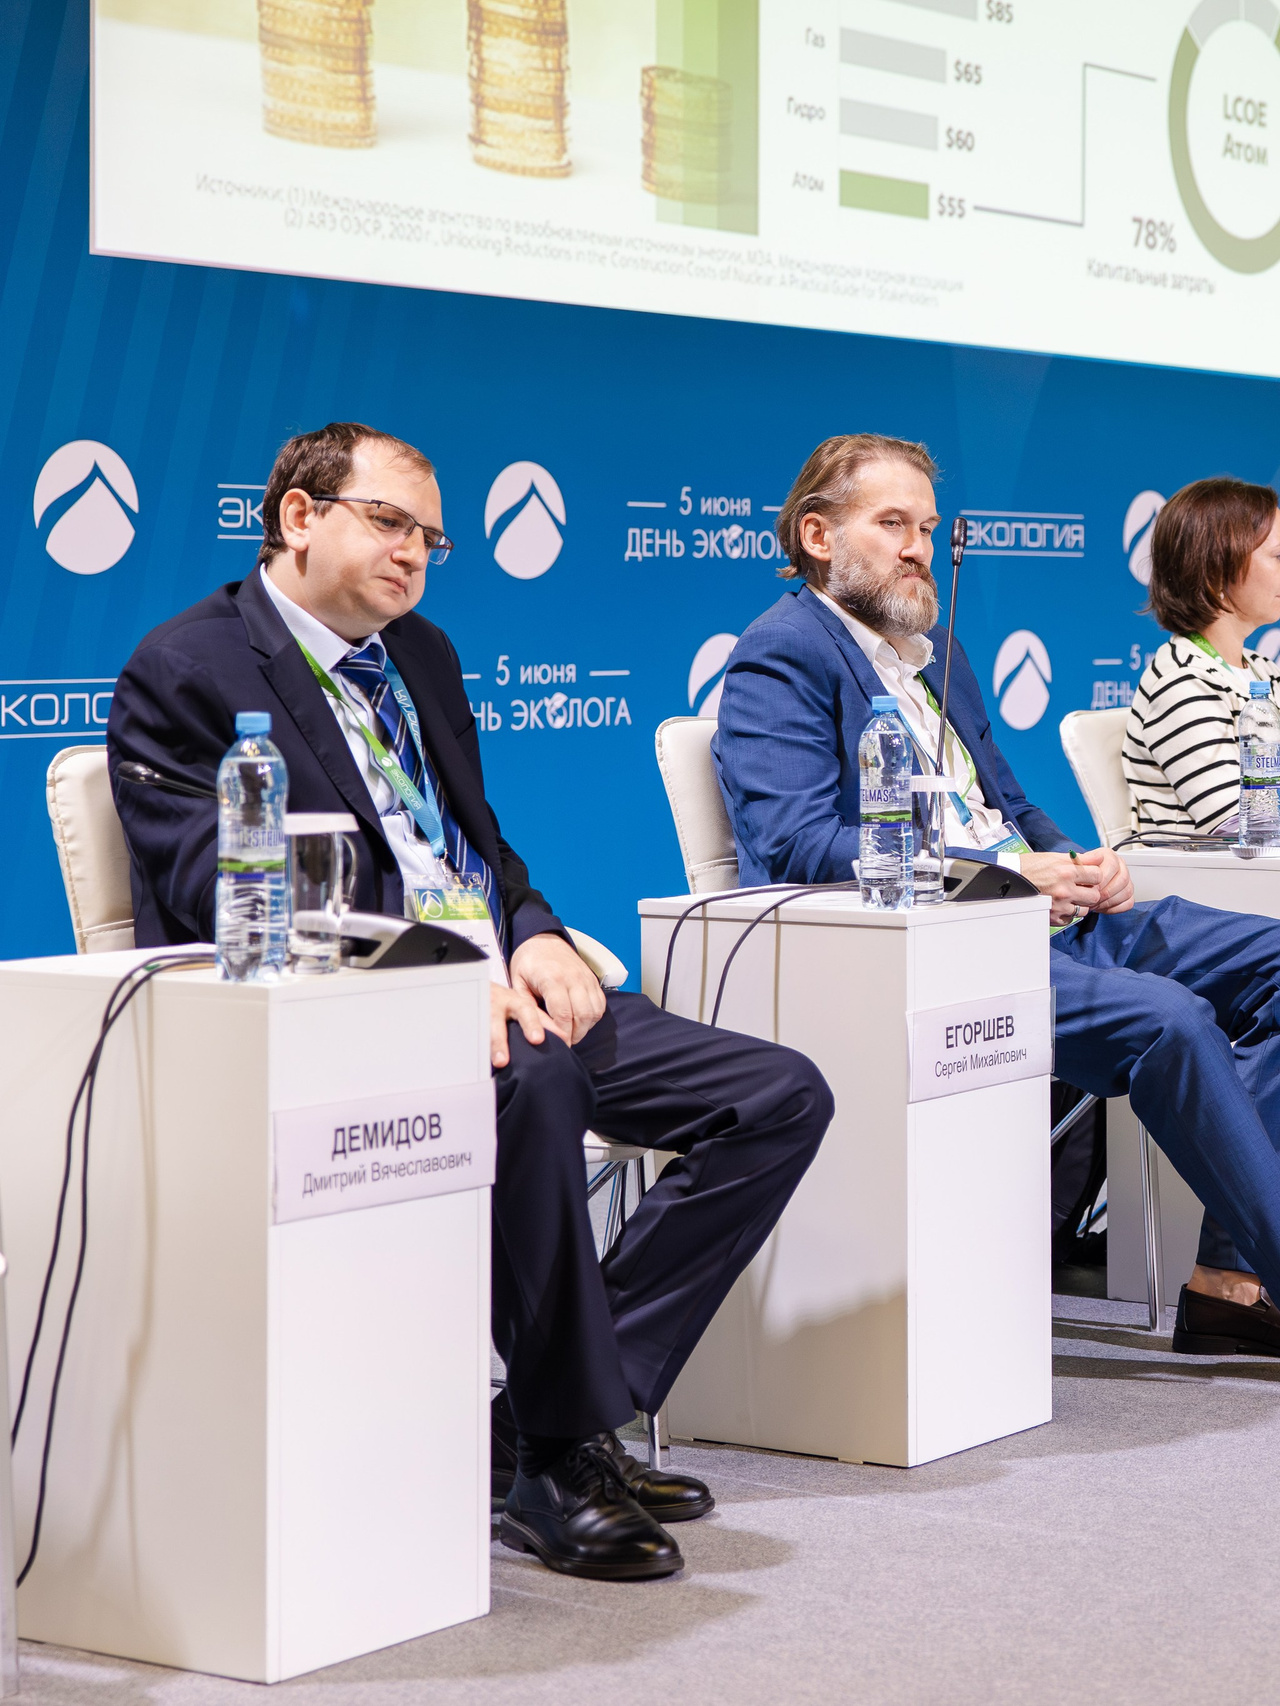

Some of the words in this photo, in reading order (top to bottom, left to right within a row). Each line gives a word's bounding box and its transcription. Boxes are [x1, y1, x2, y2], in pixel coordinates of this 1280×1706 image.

[986, 0, 1014, 24] $85
[805, 26, 826, 49] Газ
[954, 58, 983, 86] $65
[786, 96, 826, 123] Гидро
[1222, 94, 1268, 128] LCOE
[945, 125, 976, 152] $60
[1221, 132, 1269, 166] Атом
[791, 170, 825, 192] Атом
[937, 192, 967, 219] $55
[1131, 215, 1178, 254] 78%
[1086, 256, 1169, 289] Капитальные
[679, 486, 693, 516] 5
[700, 496, 752, 517] июня
[624, 527, 686, 562] ДЕНЬ
[692, 524, 787, 560] ЭКОЛО
[966, 520, 1085, 550] ЭКОЛОГИЯ
[495, 654, 511, 687] 5
[519, 663, 577, 686] июня
[1128, 643, 1142, 671] 5
[0, 691, 115, 727] КОЛО
[469, 700, 503, 731] НЬ
[510, 691, 633, 731] ЭКОЛОГА
[1090, 680, 1137, 711] ДЕНЬ
[390, 768, 424, 811] ЭКОЛОГИЯ
[861, 788, 890, 803] ELMAS
[945, 1015, 1016, 1050] ЕГОРШЕВ
[934, 1056, 969, 1079] Сергей
[970, 1047, 1028, 1072] Михайлович
[331, 1112, 443, 1162] ДЕМИДОВ
[301, 1164, 367, 1199] Дмитрий
[371, 1151, 473, 1183] Вячеславович
